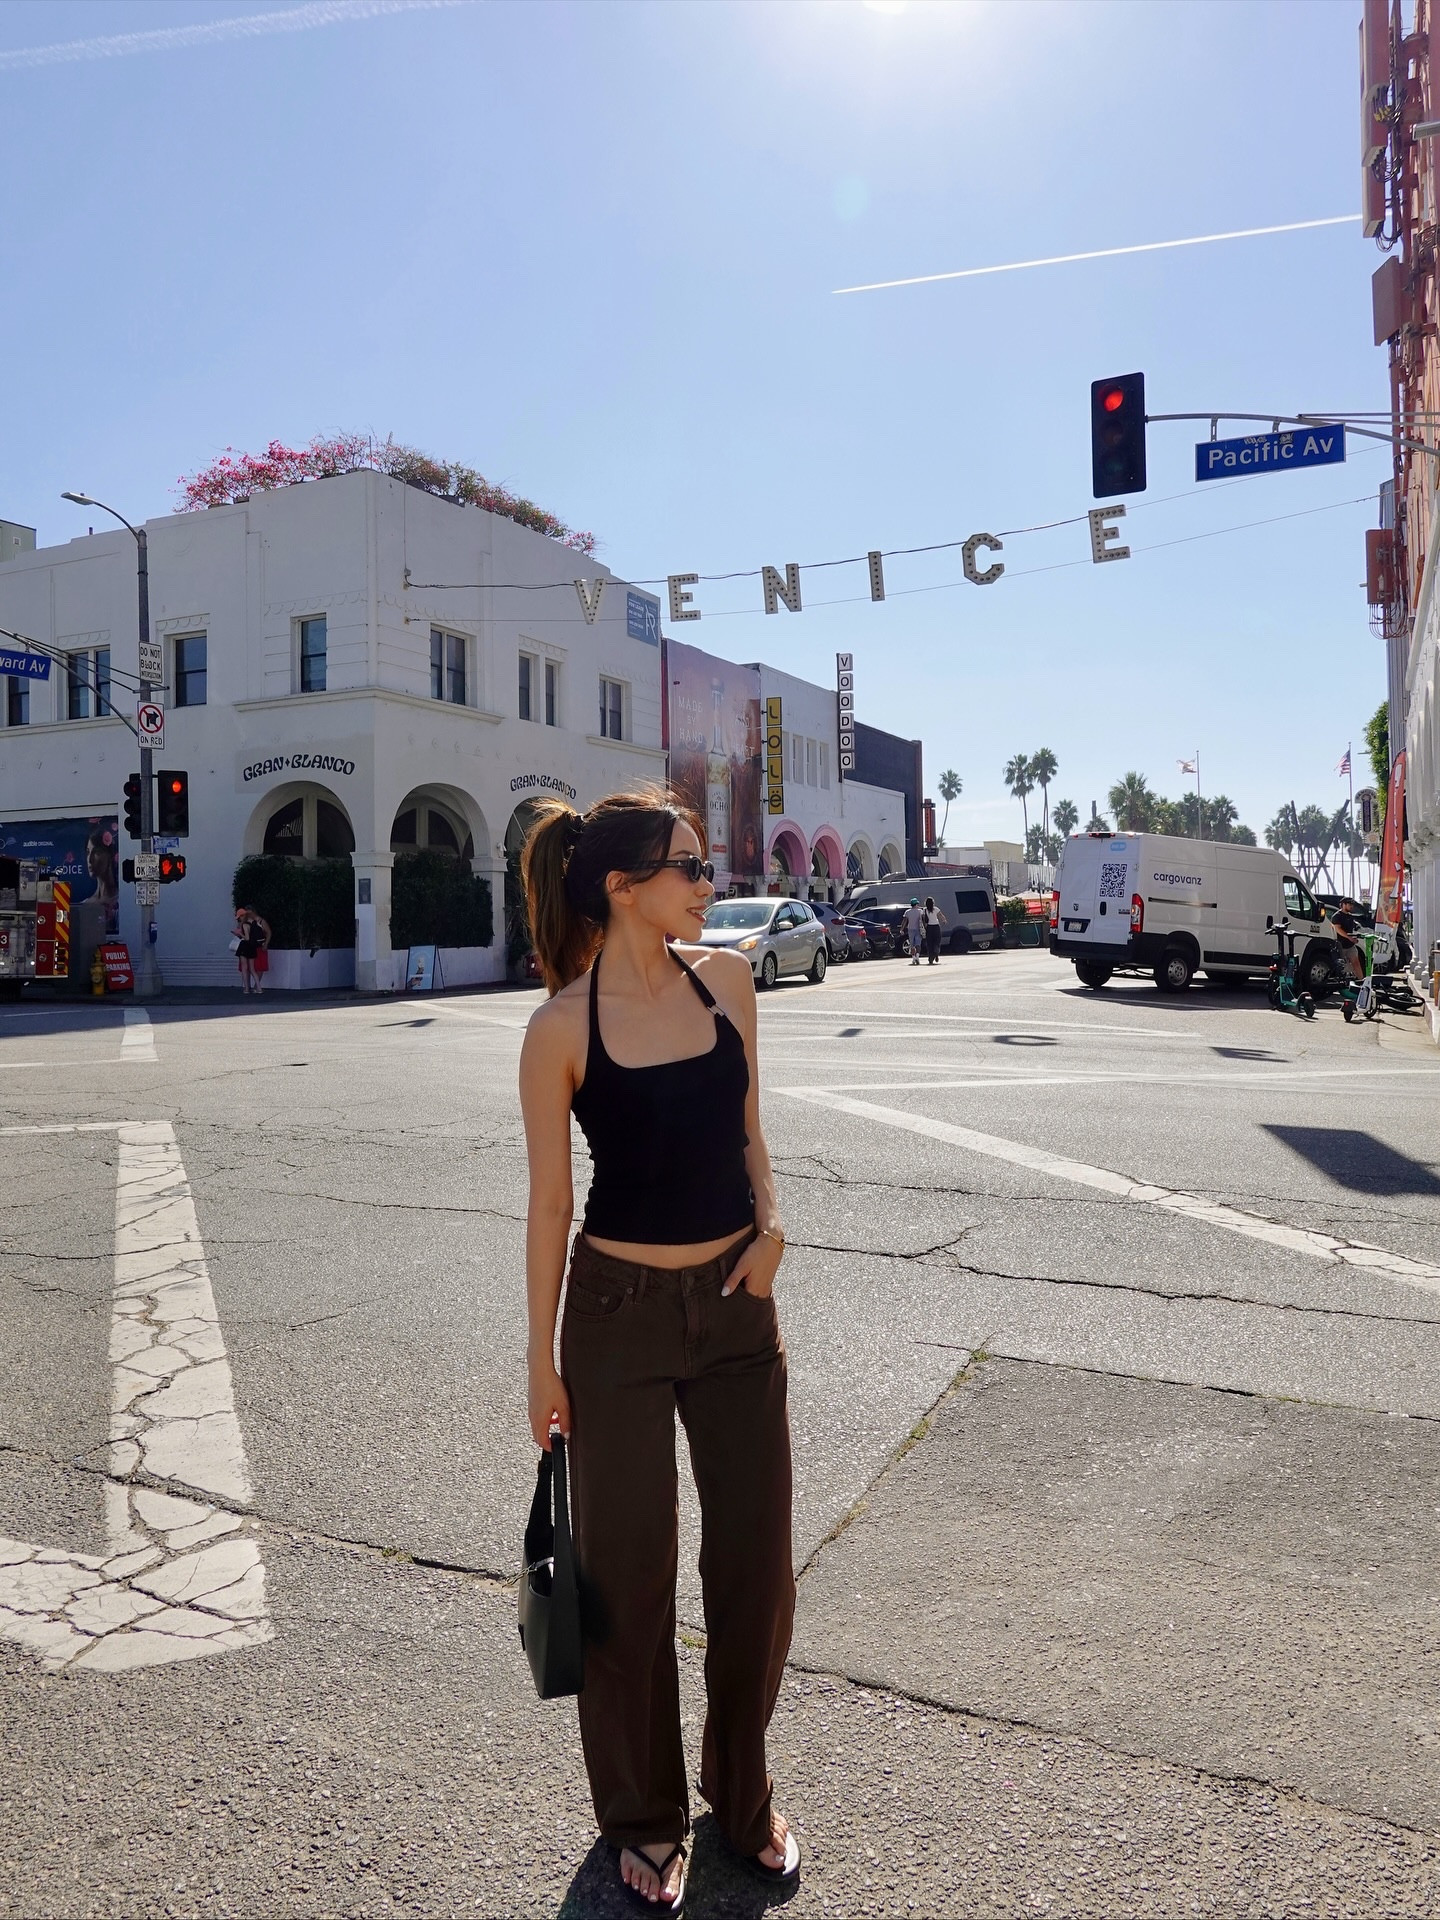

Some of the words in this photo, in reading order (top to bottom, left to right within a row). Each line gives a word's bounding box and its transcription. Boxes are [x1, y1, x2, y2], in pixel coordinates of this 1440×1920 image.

[1208, 441, 1294, 469] Pacific
[1303, 436, 1333, 456] Av
[574, 504, 1131, 625] VENICE
[140, 647, 148, 656] DO
[150, 649, 160, 659] NOT
[29, 660, 46, 673] Av
[140, 659, 161, 671] BLOCK
[679, 696, 702, 713] MADE
[840, 657, 851, 766] VOODOO
[140, 735, 148, 744] ON
[151, 736, 162, 745] RED
[243, 756, 284, 781] GRAN
[291, 754, 355, 775] BLANCO
[510, 774, 536, 791] GRAN
[540, 775, 576, 799] BLANCO
[136, 867, 145, 875] OK
[1153, 872, 1202, 886] cargovanz
[106, 952, 126, 960] PUBLIC
[105, 963, 131, 971] PARKING
